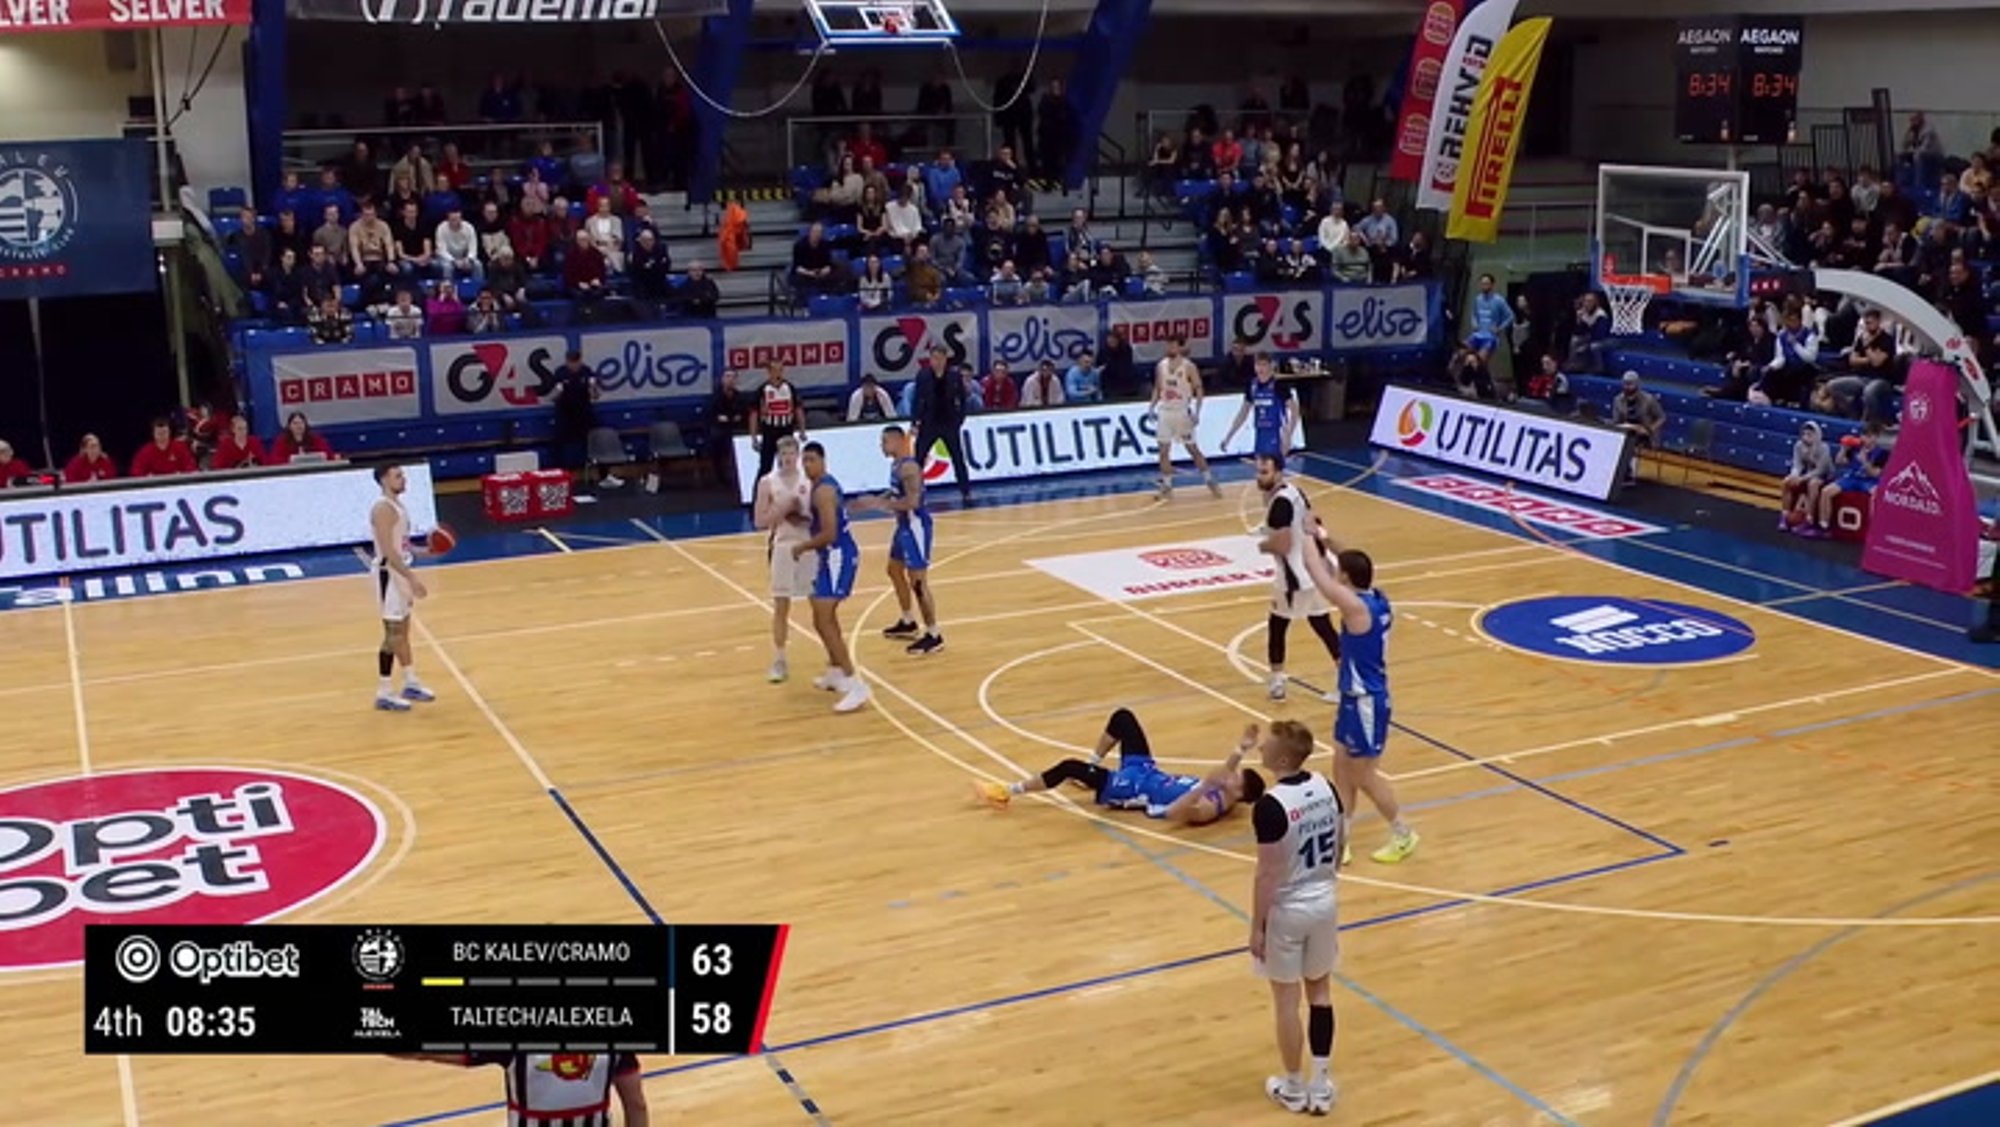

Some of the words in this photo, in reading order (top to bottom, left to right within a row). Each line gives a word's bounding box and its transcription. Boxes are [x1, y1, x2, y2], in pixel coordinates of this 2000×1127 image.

[1740, 29, 1800, 44] AEGAON
[1689, 73, 1731, 97] 8:34
[1753, 73, 1796, 97] 8:34
[1464, 74, 1522, 219] PIRELLI
[1336, 296, 1422, 337] elisa
[732, 343, 843, 368] CRAMO
[994, 316, 1094, 363] elisa
[447, 344, 556, 405] G4S
[599, 340, 707, 391] elisa
[282, 373, 413, 404] CRAMO
[962, 414, 1159, 470] UTILITAS
[1436, 410, 1592, 482] UTILITAS
[0, 495, 245, 564] TILITAS
[0, 561, 304, 605] allinn
[1298, 829, 1335, 869] 15
